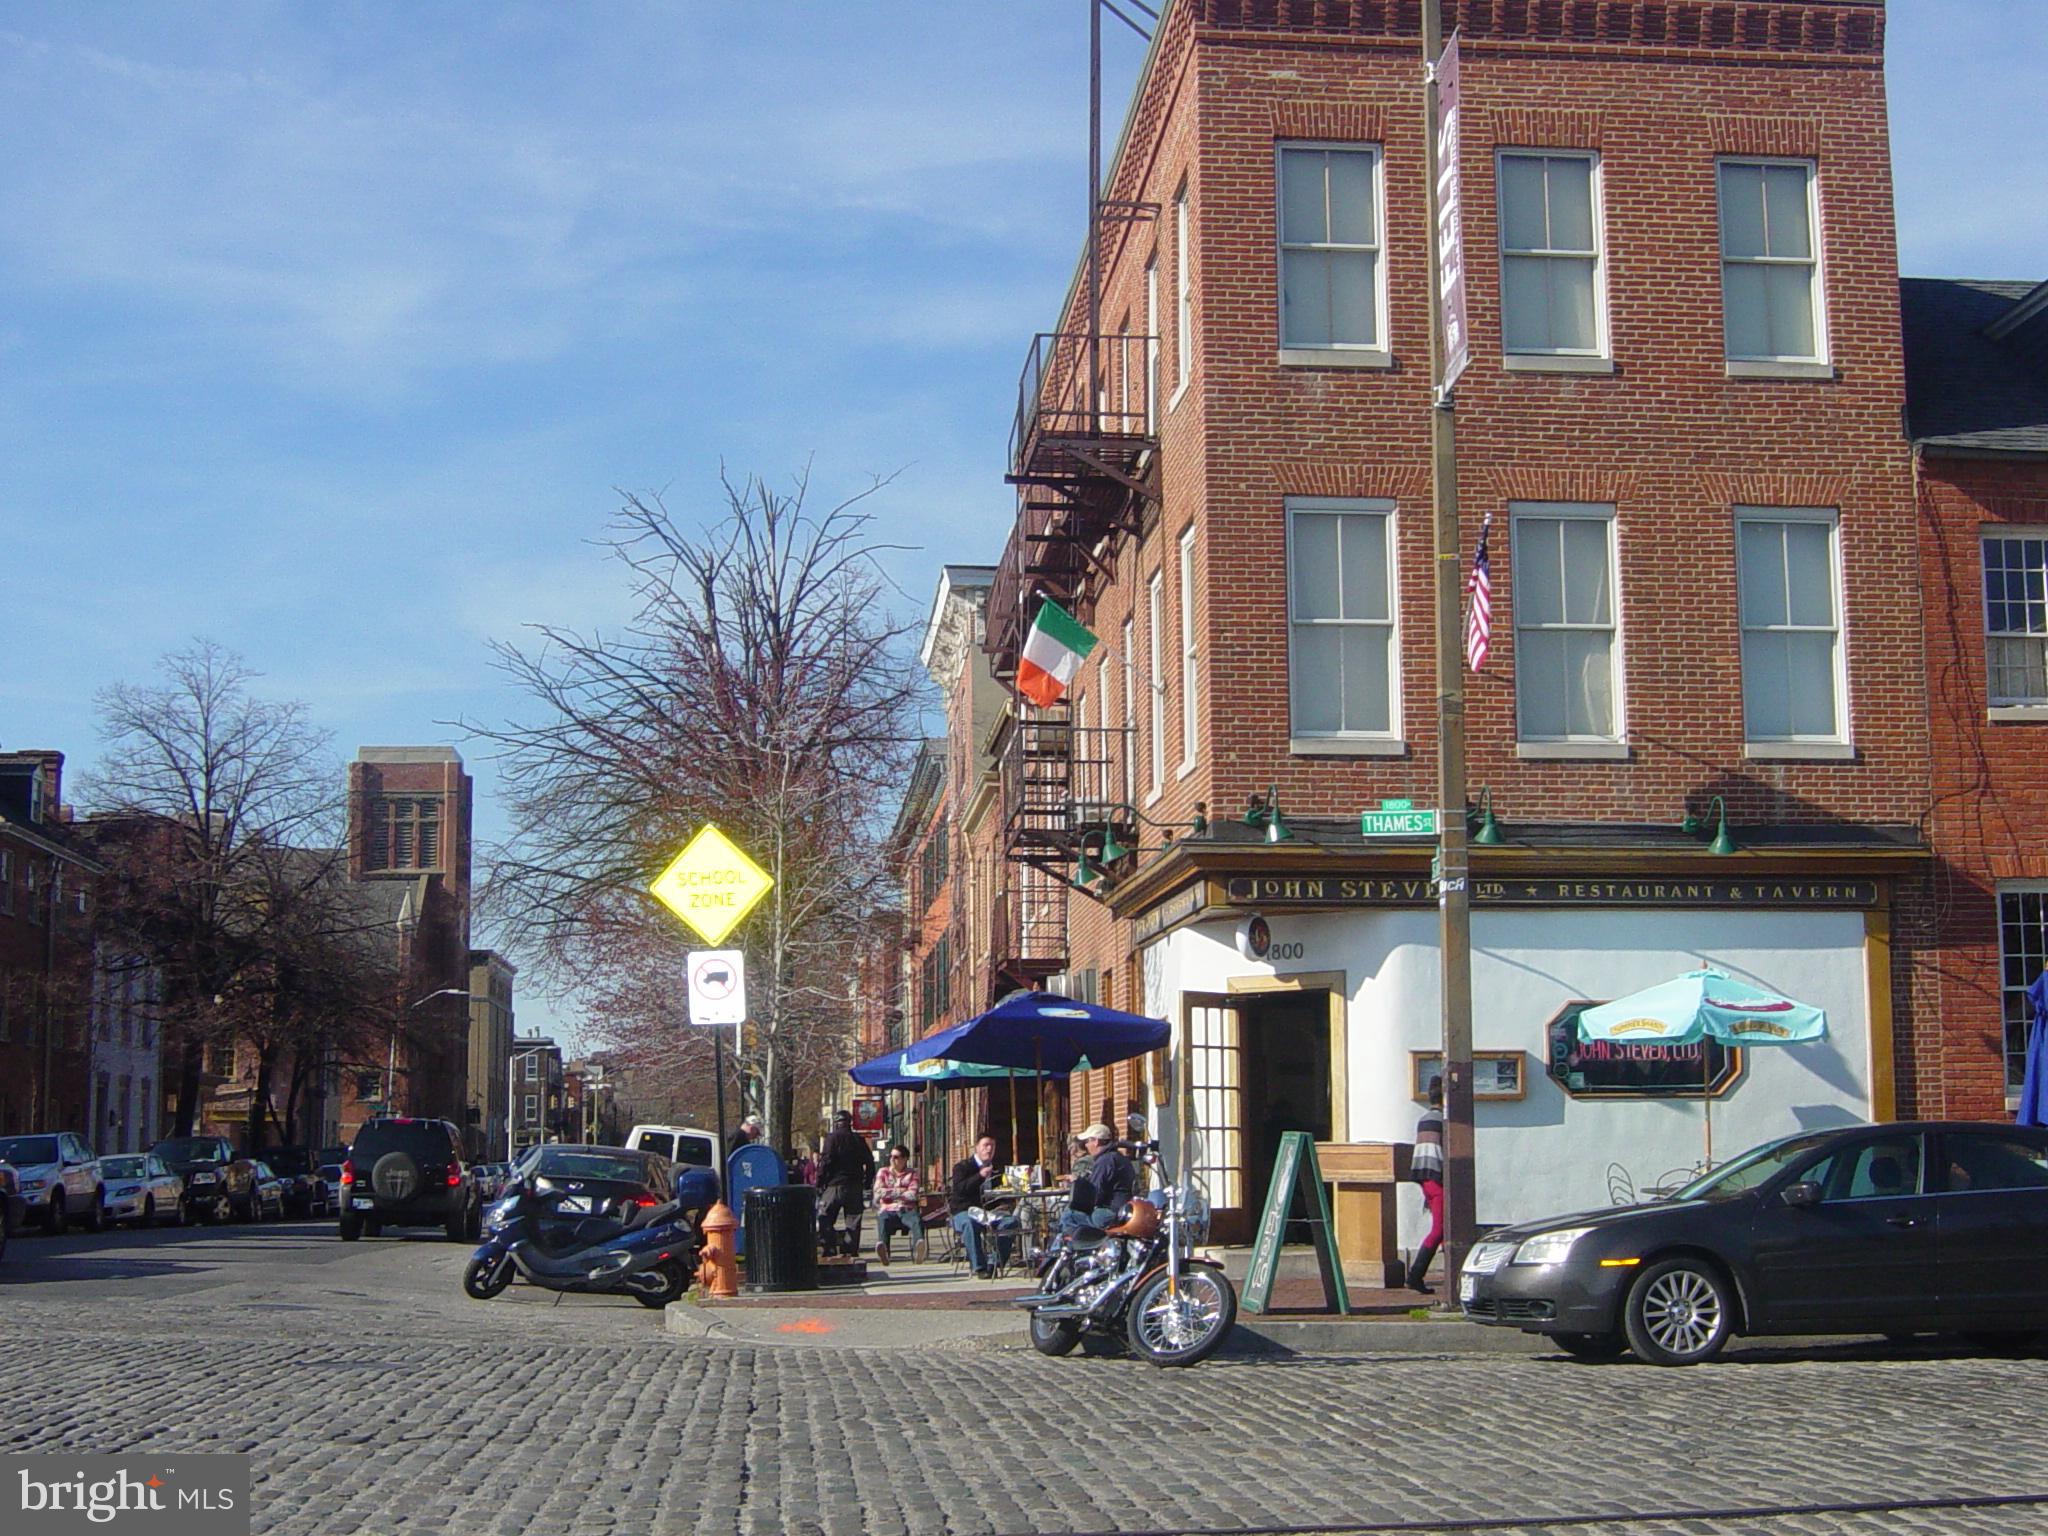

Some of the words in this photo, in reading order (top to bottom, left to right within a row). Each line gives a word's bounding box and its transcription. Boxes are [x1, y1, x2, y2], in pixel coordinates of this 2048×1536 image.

[1437, 109, 1456, 300] FELLS
[1364, 815, 1424, 832] THAMES
[677, 871, 746, 887] SCHOOL
[1246, 879, 1324, 899] JOHN
[1340, 880, 1440, 899] STEVE
[1558, 883, 1715, 899] RESTAURANT
[1728, 886, 1743, 899] &
[1755, 885, 1859, 899] TAVERN
[690, 893, 737, 908] ZONE
[1576, 1041, 1611, 1060] JOHN
[385, 1169, 410, 1178] Jeep
